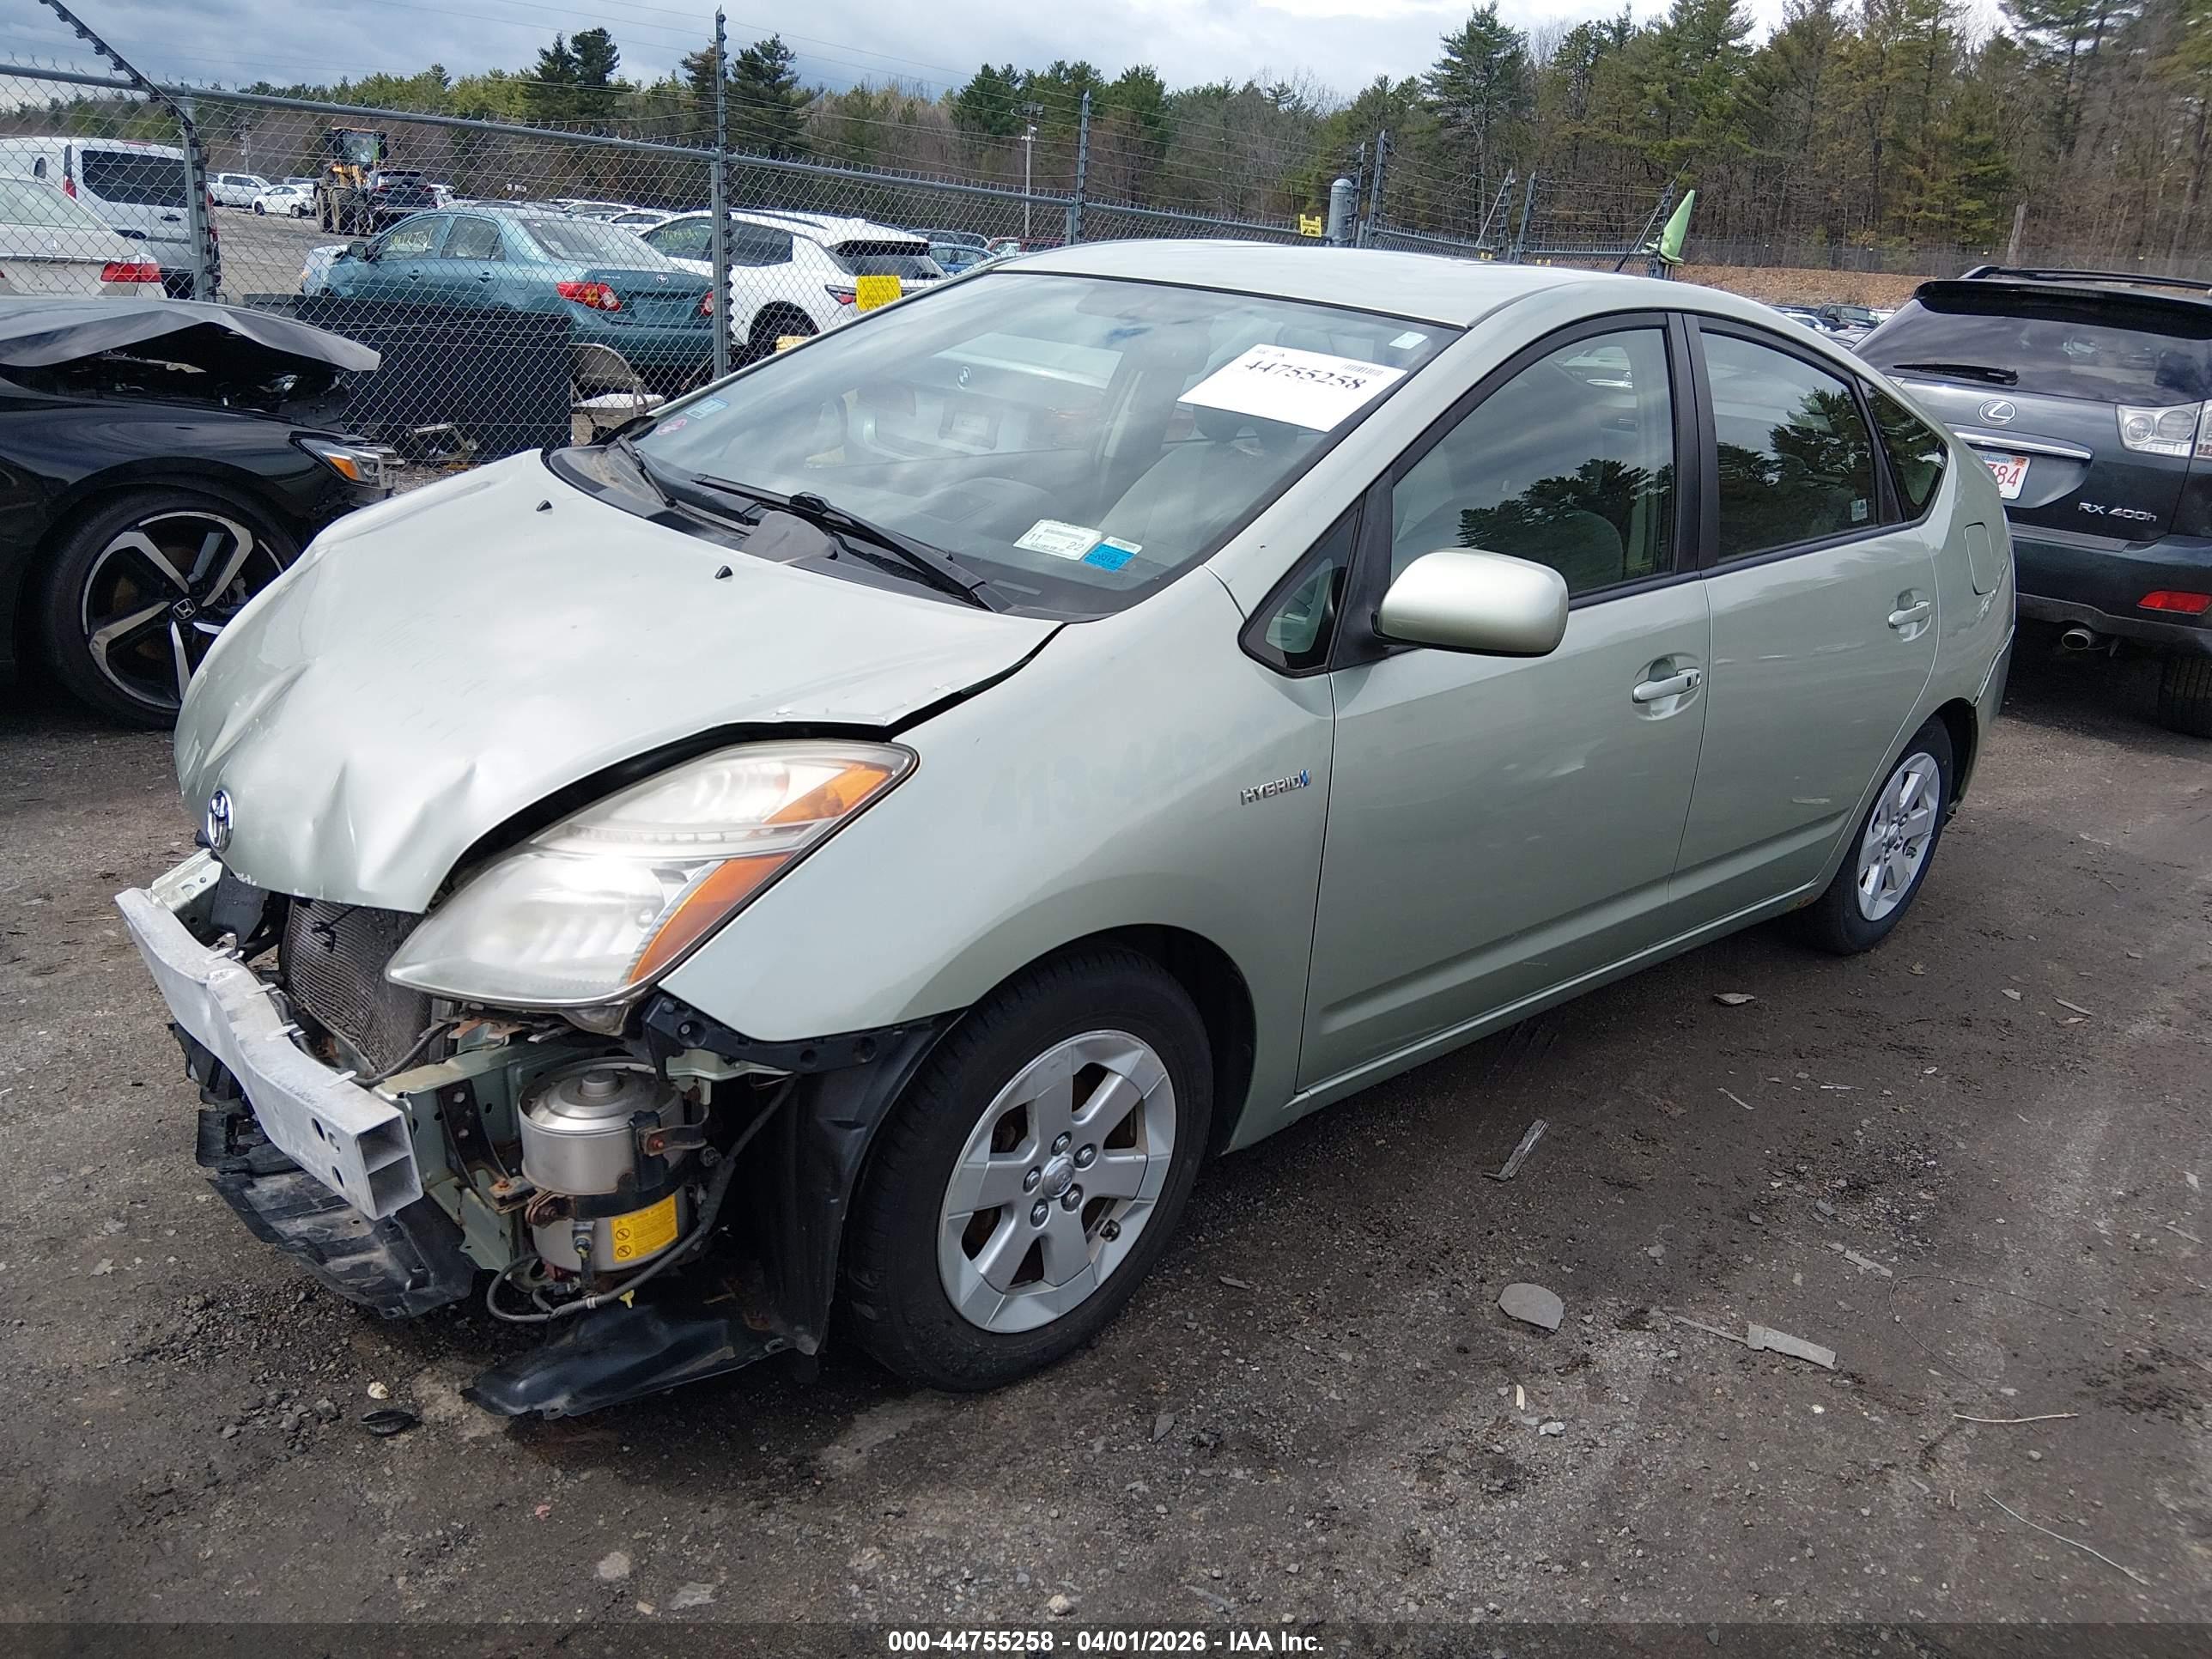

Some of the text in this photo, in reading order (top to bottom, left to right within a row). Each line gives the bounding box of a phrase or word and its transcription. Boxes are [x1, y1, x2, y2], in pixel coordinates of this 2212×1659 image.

[1245, 360, 1367, 390] 44755258
[2078, 502, 2157, 521] RX 400h
[1241, 775, 1301, 805] HYBRID
